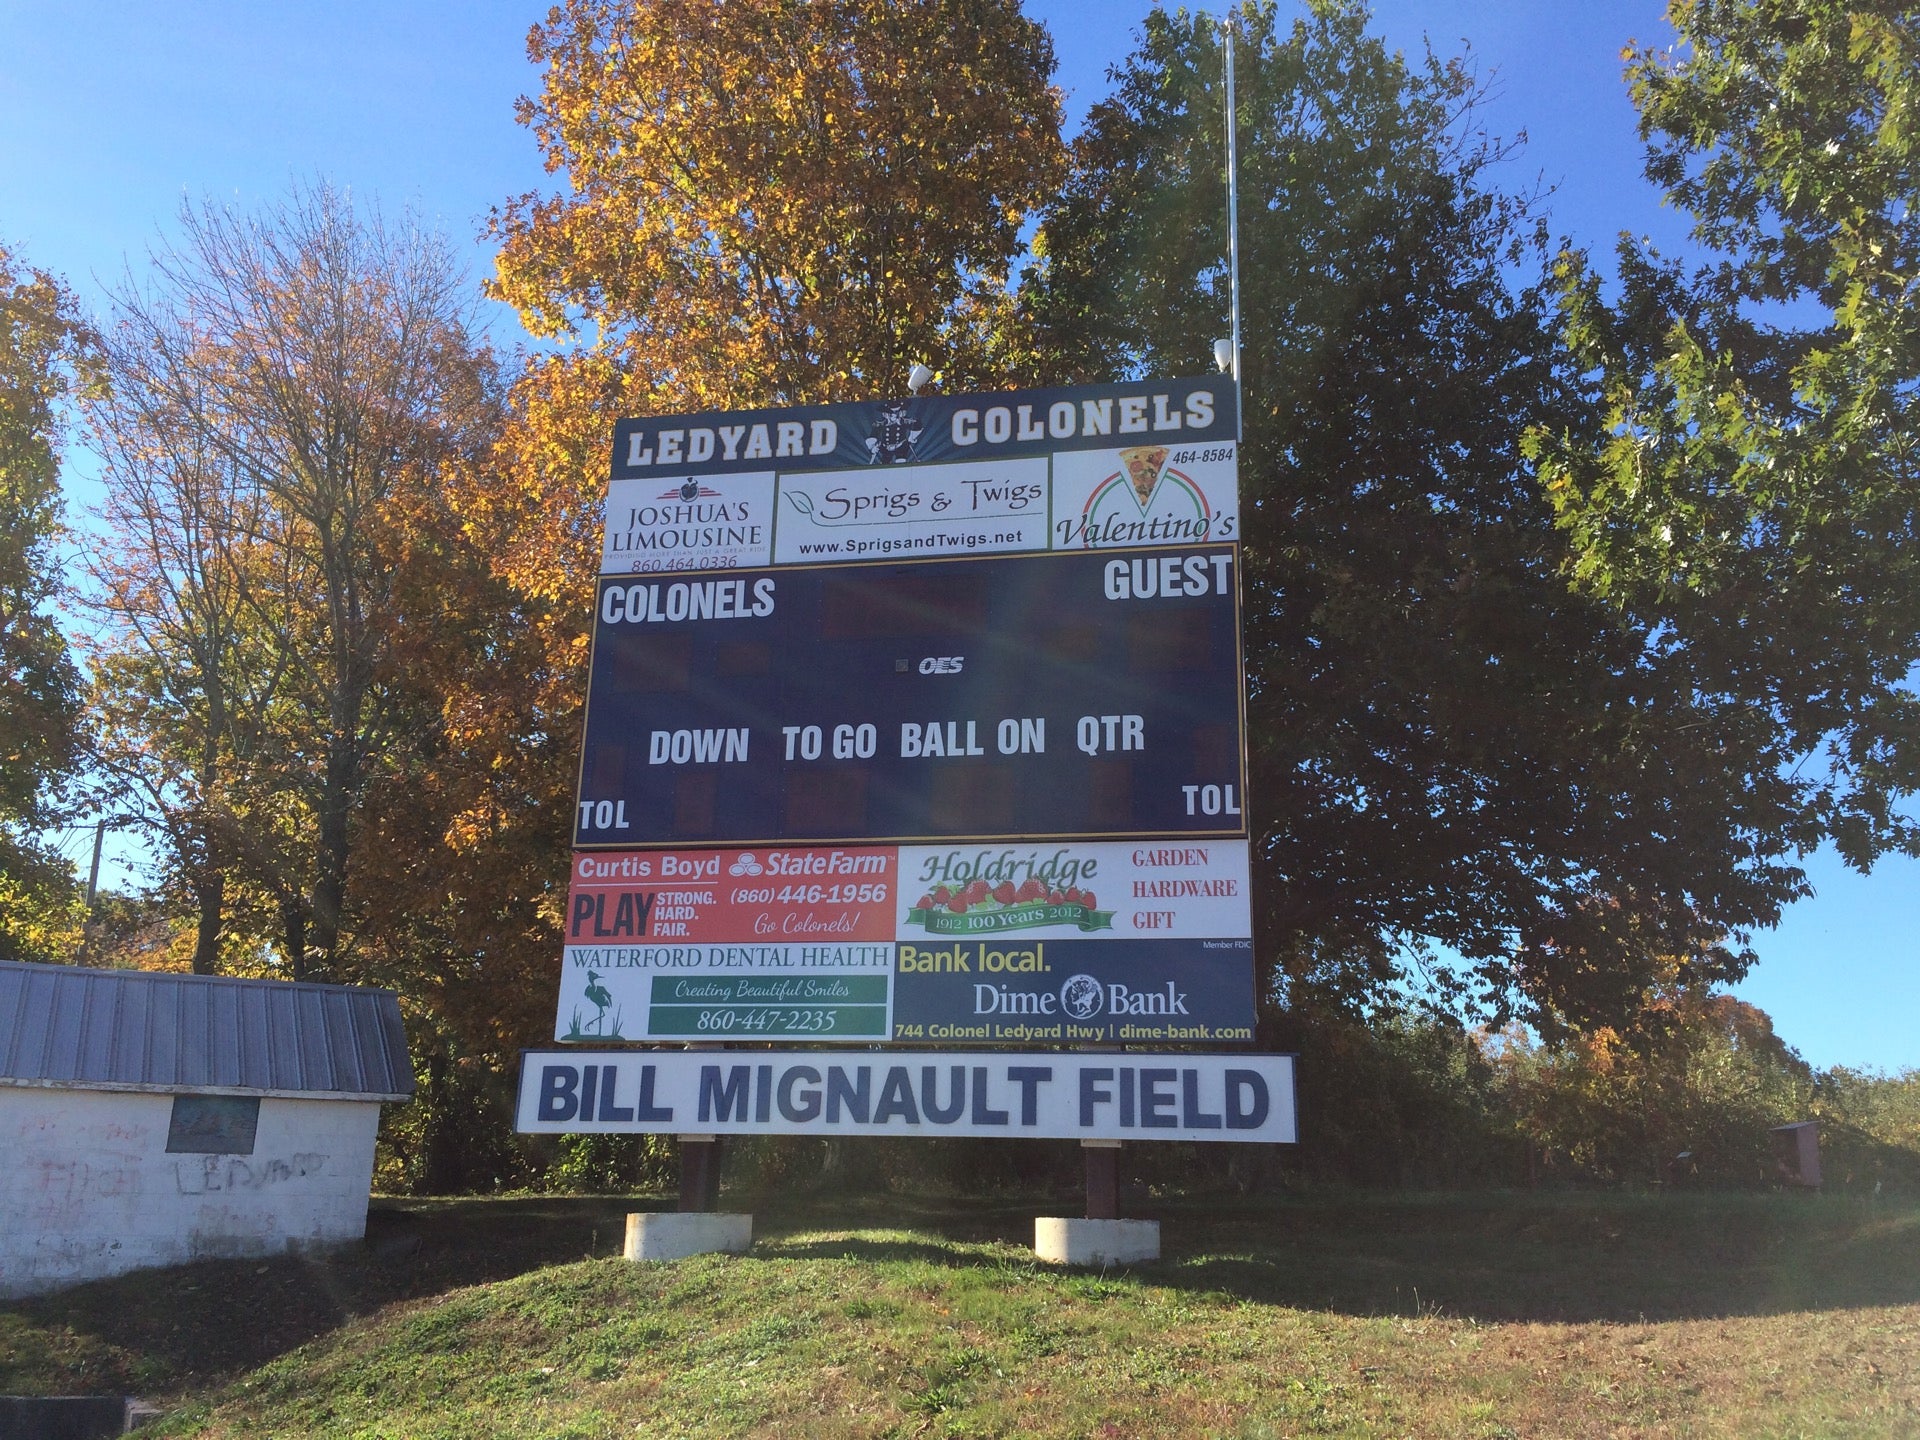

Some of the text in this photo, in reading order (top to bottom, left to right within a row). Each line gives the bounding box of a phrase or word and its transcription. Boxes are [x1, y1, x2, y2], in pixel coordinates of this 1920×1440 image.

[951, 390, 1215, 447] COLONELS
[626, 419, 838, 467] LEDYARD
[1172, 447, 1233, 465] 464-8584
[820, 479, 1042, 520] Sprigs & Twigs
[628, 502, 749, 531] JOSHUA'S
[1056, 511, 1236, 545] Valentino's
[612, 526, 762, 552] LIMOUSINE
[799, 530, 1023, 555] www.SprigsandTwigs.net
[631, 555, 737, 573] 860.464.0336
[1104, 554, 1233, 600] GUEST
[601, 578, 776, 624] COLONELS
[918, 656, 965, 674] OES
[649, 727, 749, 765] DOWN
[782, 723, 877, 761] TO GO
[900, 717, 1045, 758] BALL ON
[1076, 714, 1145, 756] QTR
[1181, 784, 1241, 815] TOL
[579, 799, 630, 830] TOL
[578, 855, 720, 880] Curtis Boyd
[918, 849, 1098, 890] Holdridge
[1132, 848, 1209, 867] GARDEN
[656, 891, 717, 905] STRONG.
[730, 883, 888, 905] (860) 446-1956
[1132, 879, 1238, 898] HARDWARE
[571, 893, 655, 937] PLAY
[654, 906, 699, 920] HARD.
[754, 911, 860, 934] Go Colonels!
[936, 906, 1082, 930] 1912 100 Years 2012
[1132, 911, 1176, 929] GIFT
[653, 922, 690, 937] FAIR.
[571, 946, 889, 968] WATERFORD DENTAL HEALTH
[1203, 940, 1252, 949] Member FDIC
[899, 942, 1051, 973] Bank local.
[675, 979, 850, 1001] Creating Beautiful Smiles
[973, 981, 1190, 1015] Dime Bank
[697, 1008, 836, 1033] 860-447-2235
[895, 1024, 1251, 1042] 744 Colonel Ledyard Hwy dime-bank.com
[538, 1065, 1270, 1131] BILL MIGNAULT FIELD
